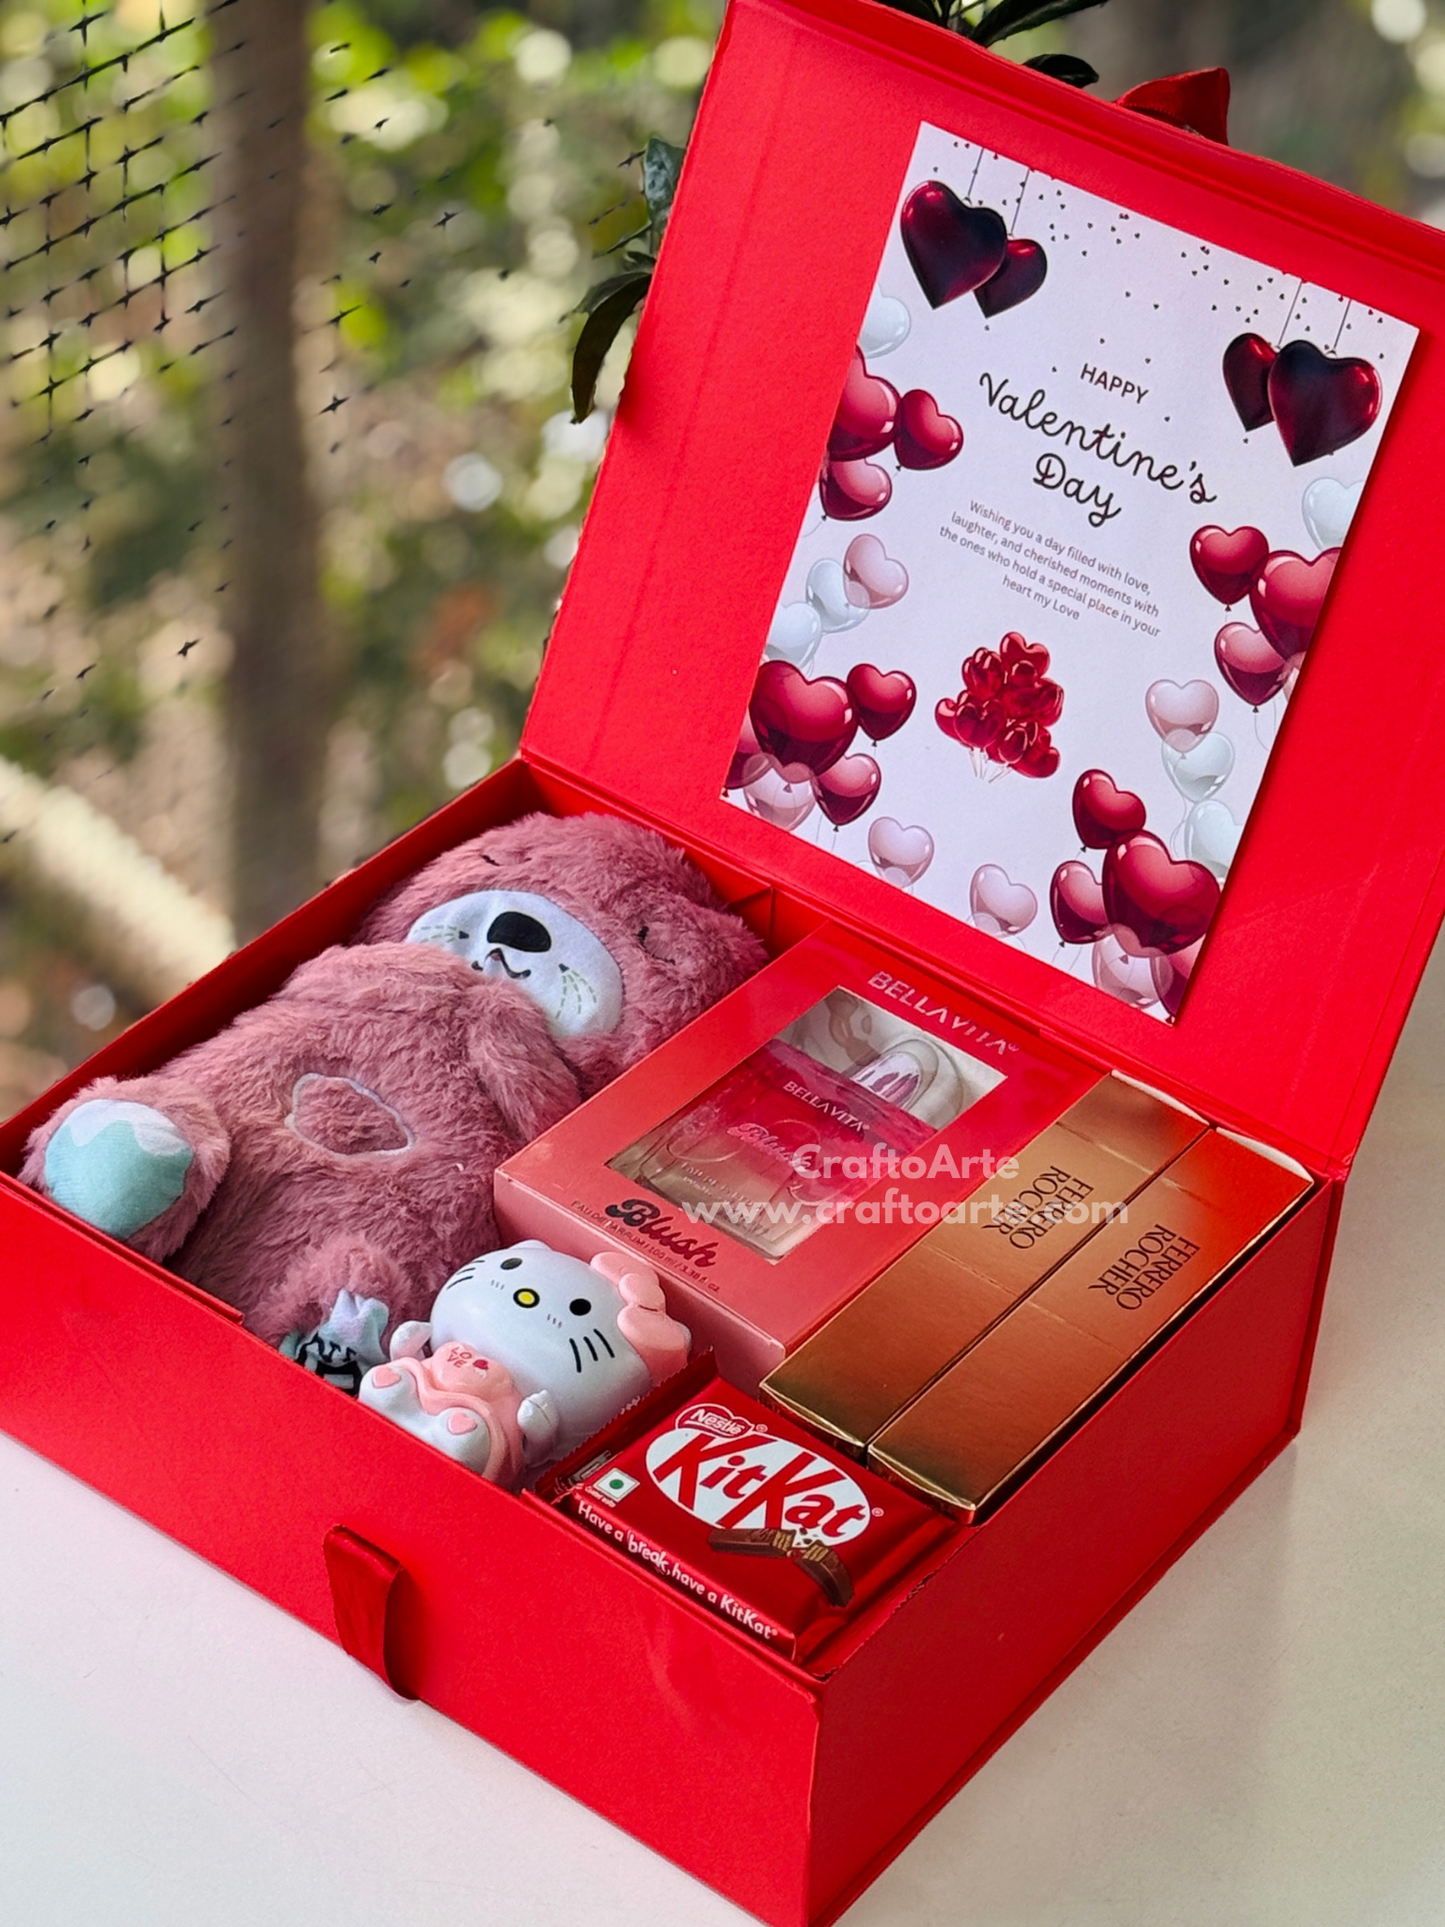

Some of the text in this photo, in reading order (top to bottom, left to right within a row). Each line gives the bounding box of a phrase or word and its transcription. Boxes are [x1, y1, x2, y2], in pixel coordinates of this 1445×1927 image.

[1080, 363, 1149, 404] HAPPY
[979, 372, 1217, 504] Valentine's
[1033, 452, 1122, 528] Day
[939, 526, 1161, 637] the ones who hold a special place in your
[951, 511, 1160, 617] laughter, and cherished moments with
[970, 499, 1151, 596] Wishing you a day filled with love,
[1002, 574, 1081, 620] heart my Love
[604, 1199, 719, 1268] Blush
[981, 1165, 1072, 1236] ROCHER
[1009, 1178, 1095, 1249] FERRERO
[649, 1246, 665, 1260] 100
[1087, 1223, 1177, 1296] ROCHER
[1116, 1236, 1202, 1310] FERRERO
[684, 1408, 746, 1436] Nestlé
[652, 1434, 866, 1538] KitKat
[578, 1500, 613, 1535] Have
[613, 1529, 624, 1543] a
[671, 1562, 706, 1595] have
[707, 1590, 718, 1605] a
